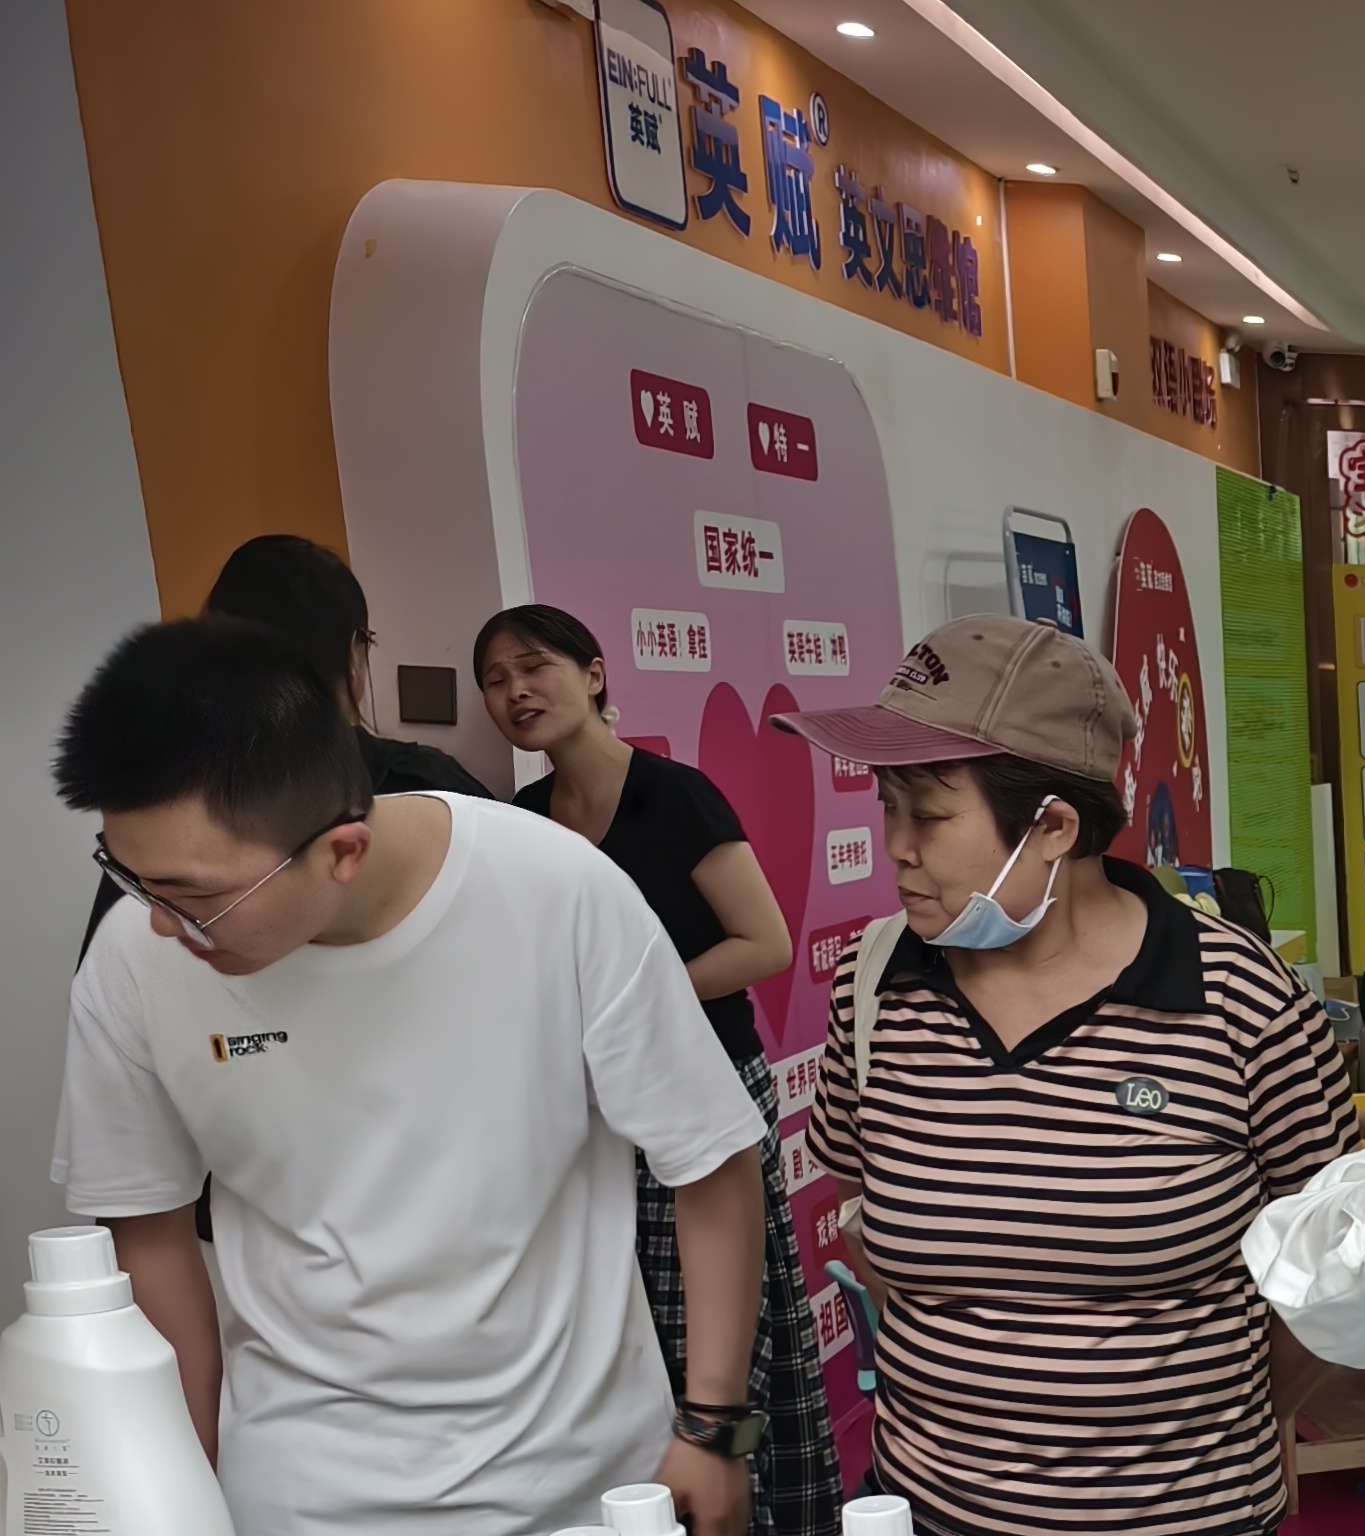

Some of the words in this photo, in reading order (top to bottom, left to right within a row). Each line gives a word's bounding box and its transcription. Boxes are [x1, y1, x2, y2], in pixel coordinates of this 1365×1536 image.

[606, 47, 673, 112] EIN:FULL
[628, 102, 661, 154] 英赋
[677, 47, 821, 270] 英赋
[836, 164, 983, 338] 英文思维馆
[656, 391, 700, 443] 英赋
[703, 525, 774, 577] 国家统一
[229, 1042, 267, 1057] rock
[1126, 1083, 1162, 1110] Leo
